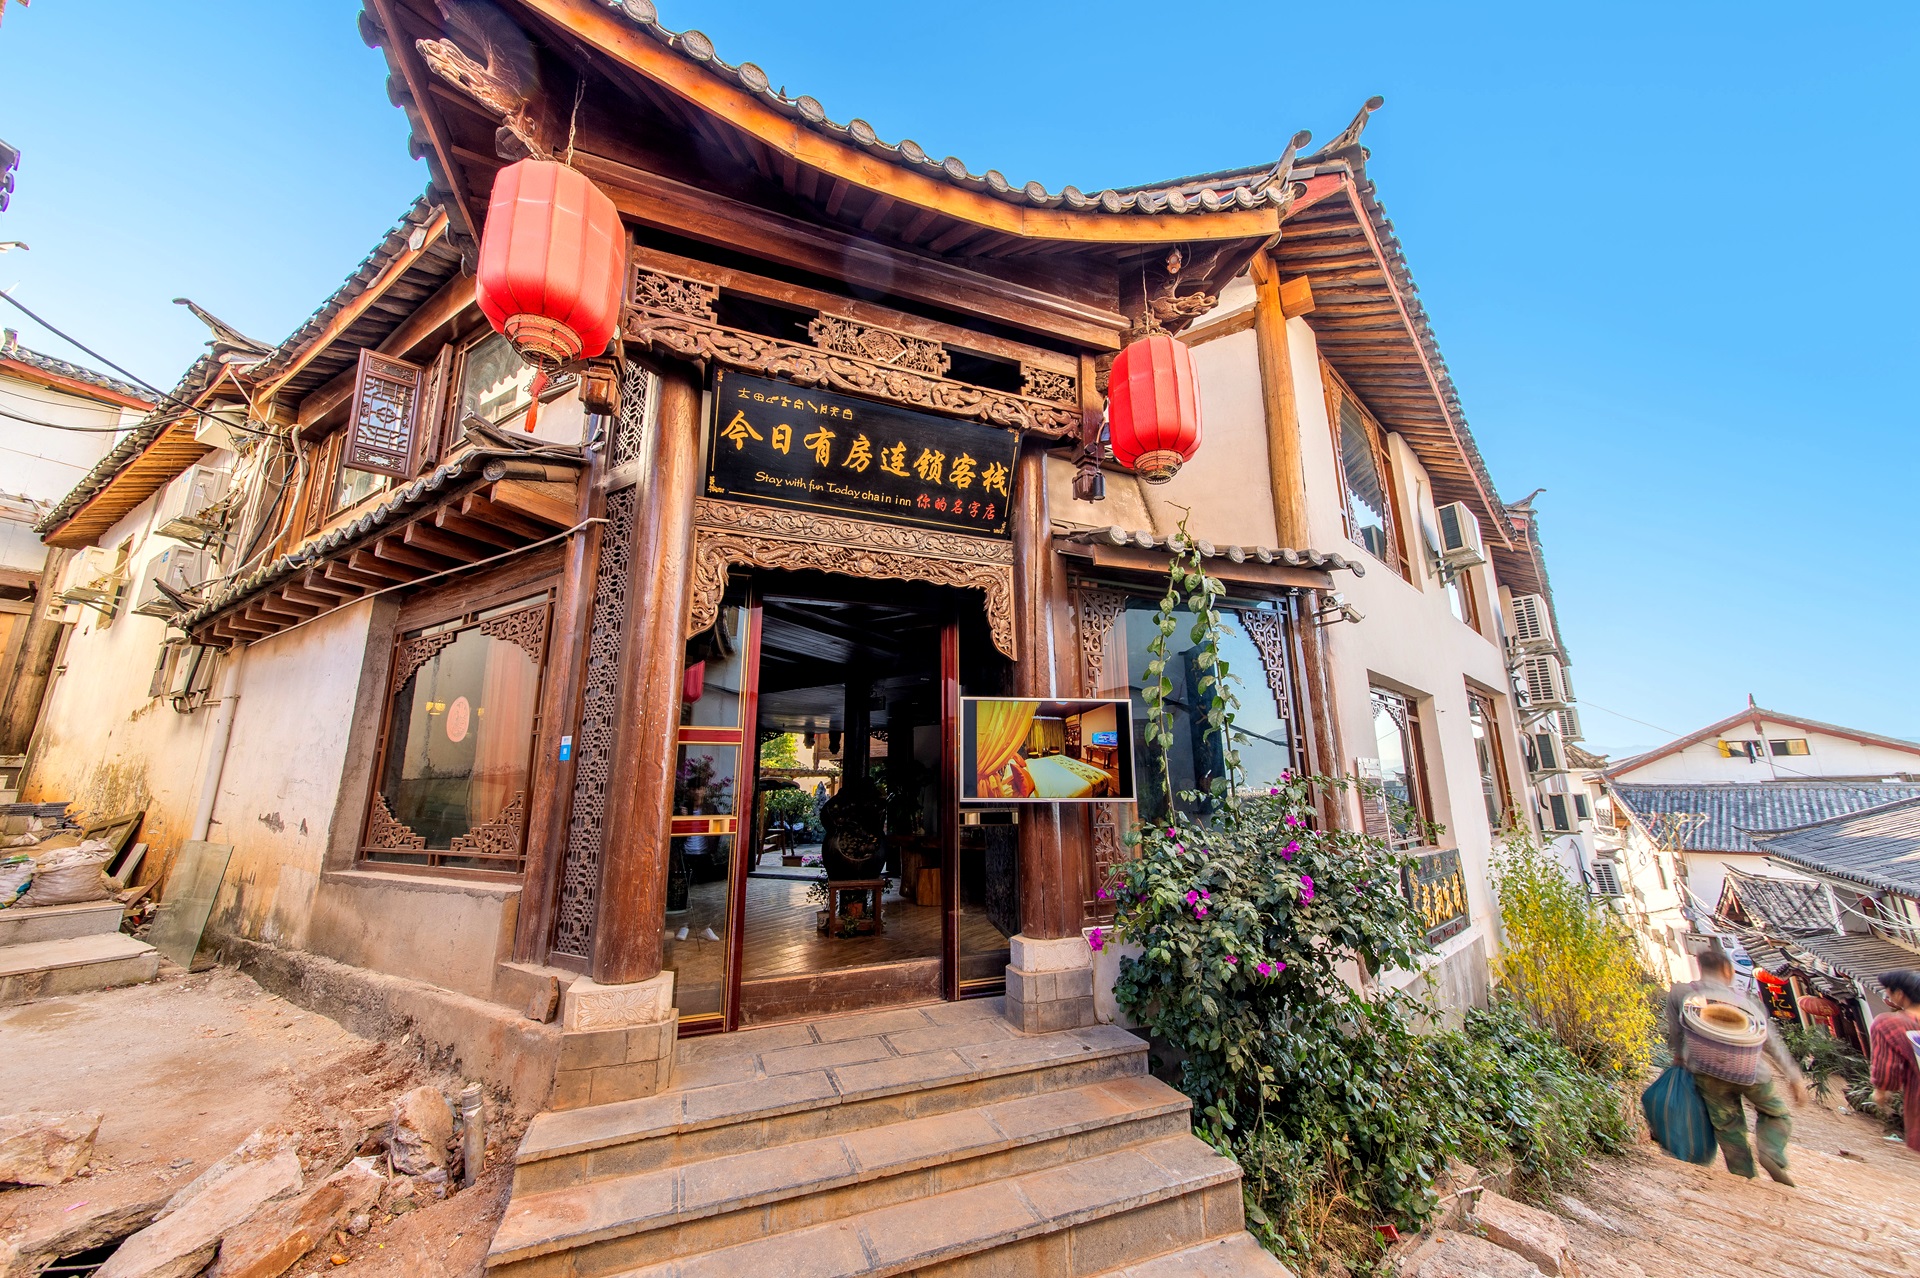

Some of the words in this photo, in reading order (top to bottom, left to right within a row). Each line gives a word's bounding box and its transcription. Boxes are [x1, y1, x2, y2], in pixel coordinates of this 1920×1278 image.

[721, 410, 1009, 497] 今日有房连锁客栈
[754, 471, 783, 487] Stay
[784, 478, 807, 489] with
[808, 479, 824, 493] fun
[826, 482, 861, 499] Today
[861, 490, 892, 504] chain
[895, 494, 912, 507] inn
[916, 493, 996, 520] 你的名字店
